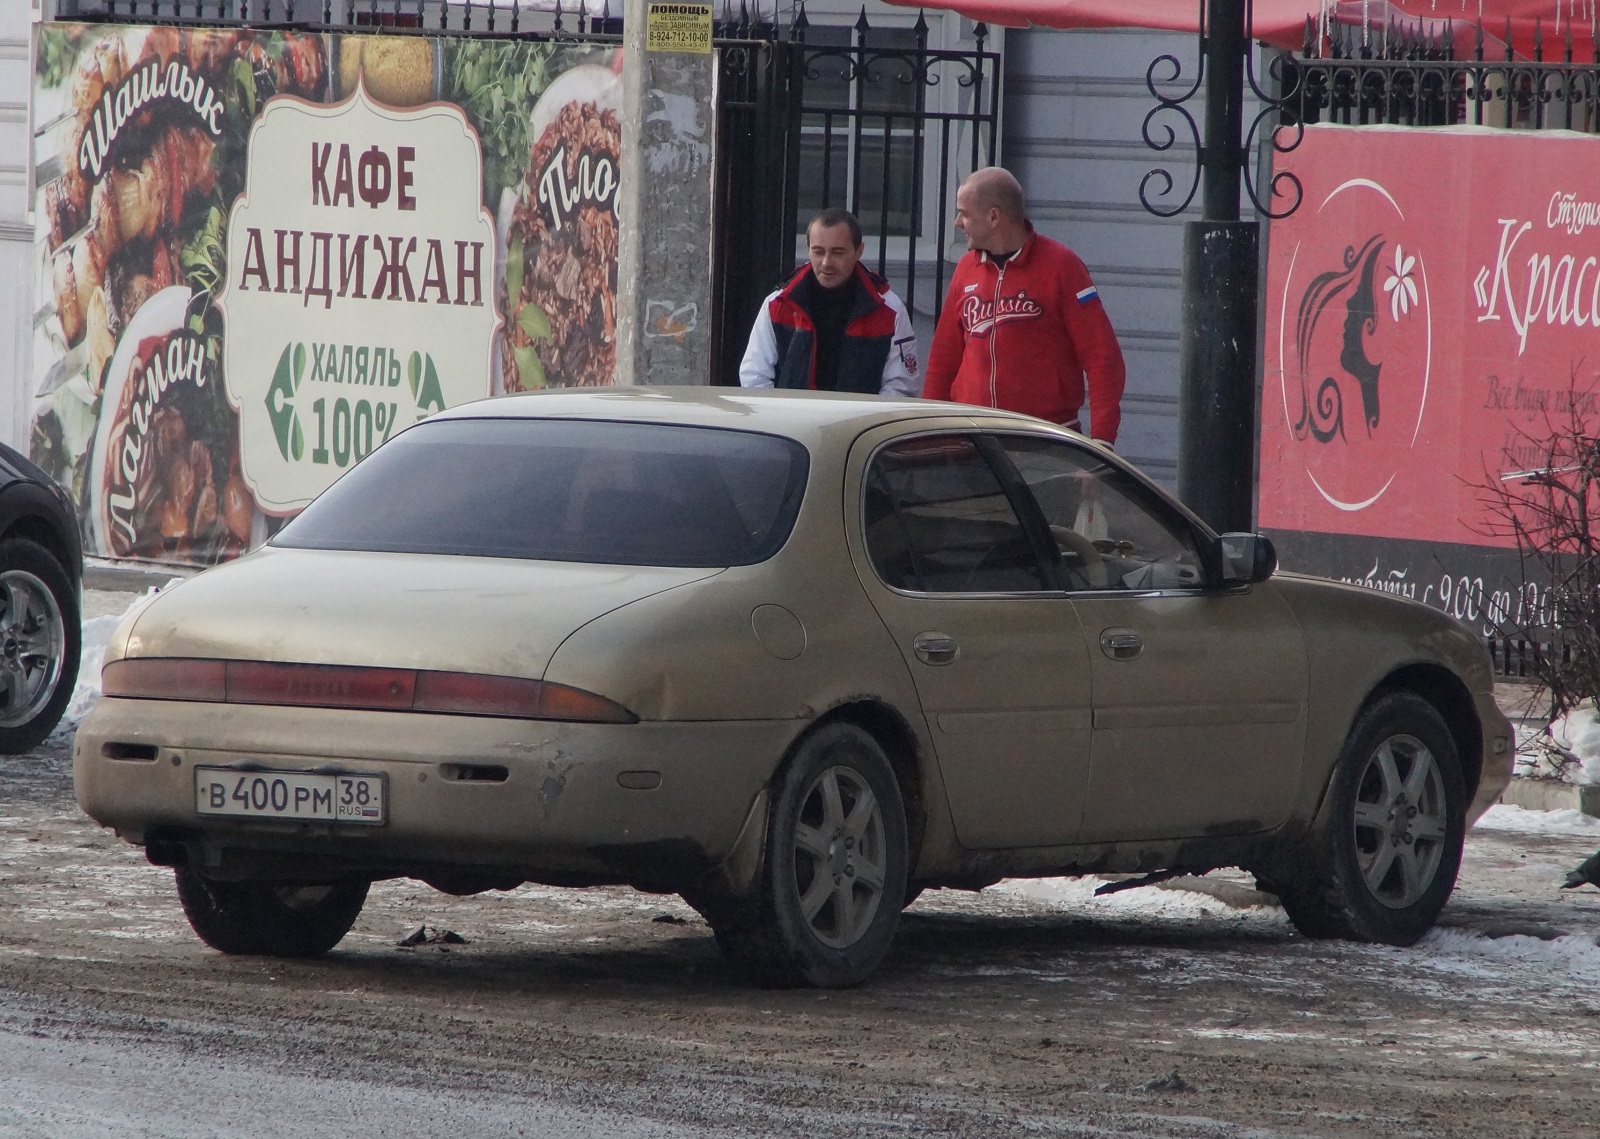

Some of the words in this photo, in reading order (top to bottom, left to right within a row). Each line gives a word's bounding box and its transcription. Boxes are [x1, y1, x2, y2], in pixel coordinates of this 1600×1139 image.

[651, 5, 709, 15] ПОМОЩЬ
[649, 31, 709, 42] 8-924-712-10-00
[80, 62, 224, 176] Шашлык
[311, 142, 416, 211] КАФЕ
[239, 227, 485, 309] АНДИЖАН
[963, 292, 1042, 333] Russia
[310, 342, 402, 387] ХАЛЯЛЬ
[110, 336, 206, 544] Лагман
[312, 397, 398, 468] 100%
[1484, 591, 1510, 637] до
[339, 806, 361, 816] RUS
[340, 780, 370, 805] 38
